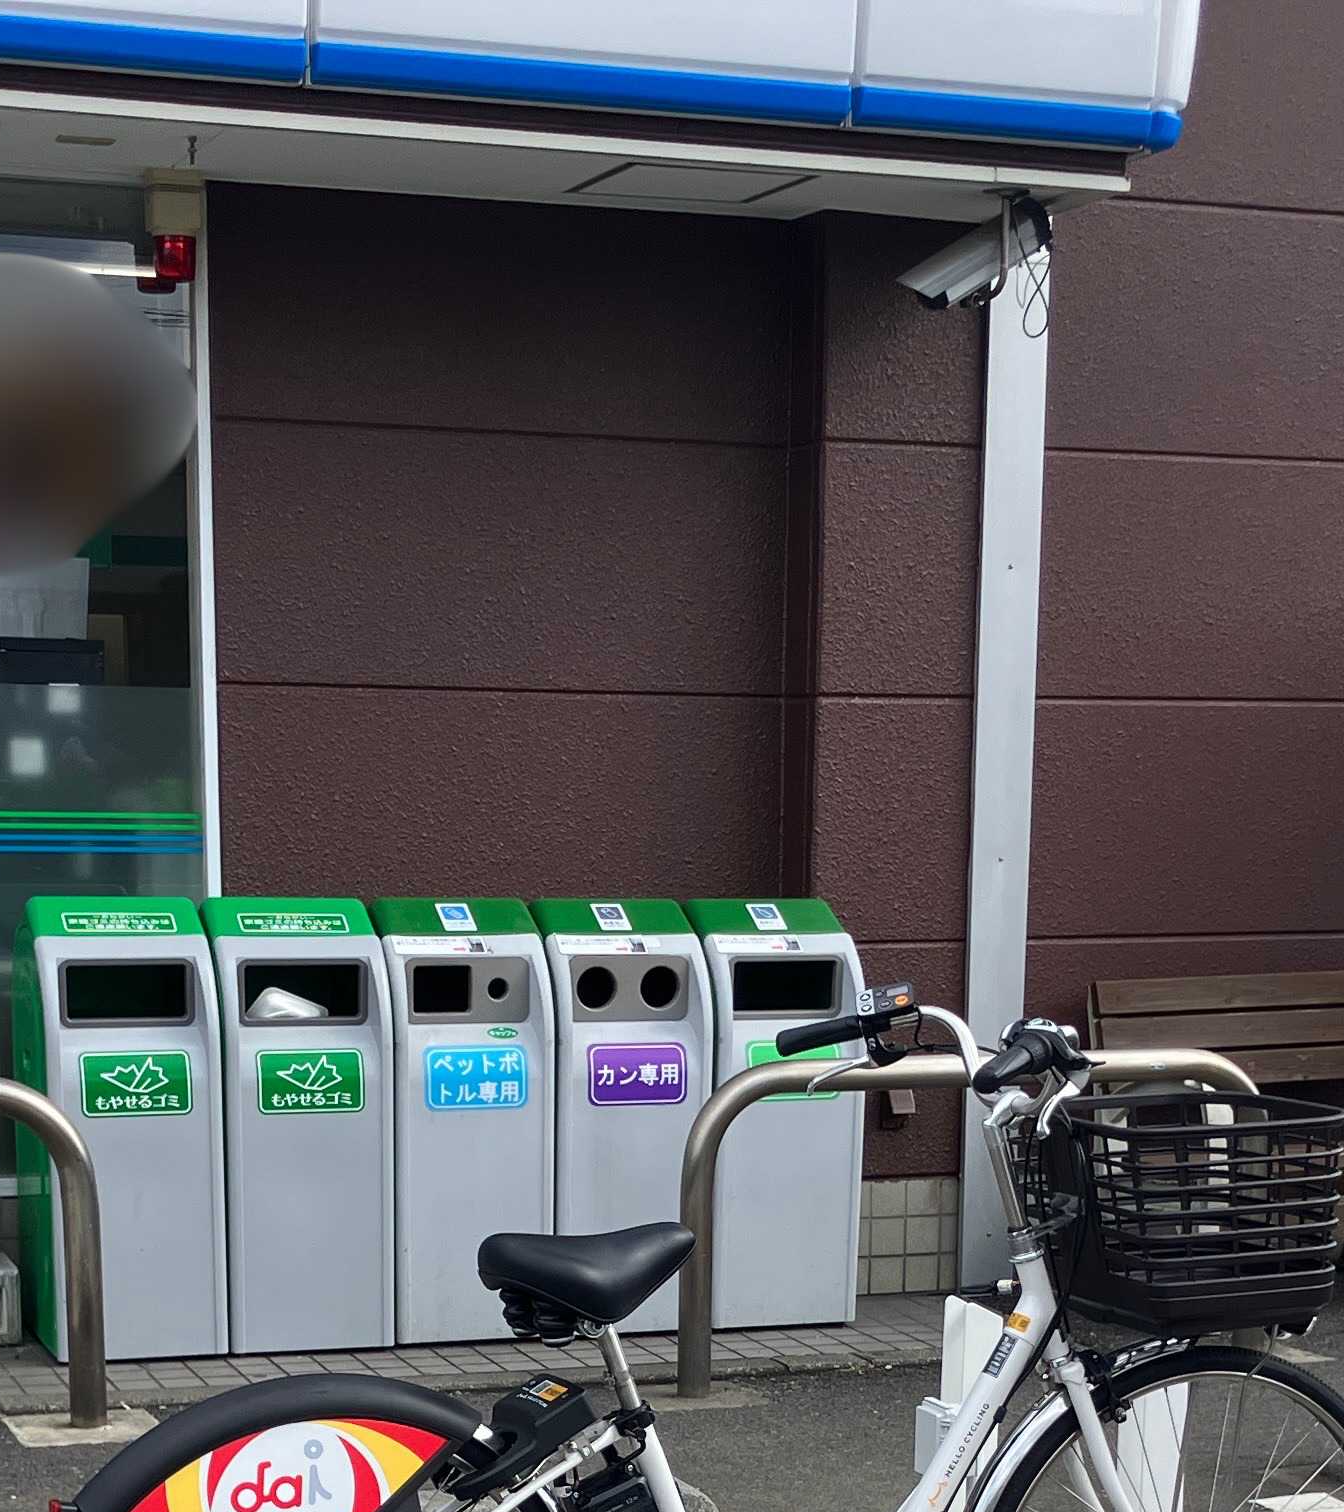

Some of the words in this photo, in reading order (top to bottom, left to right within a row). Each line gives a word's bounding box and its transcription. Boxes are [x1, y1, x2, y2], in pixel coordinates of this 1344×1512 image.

[433, 1052, 520, 1076] ペットボ
[597, 1063, 679, 1088] カン専用
[95, 1095, 181, 1110] もやせるゴミ
[271, 1093, 353, 1107] もやせるゴミ
[439, 1079, 521, 1104] トル専用
[945, 1446, 966, 1478] HELLO
[963, 1402, 990, 1444] CYCLING
